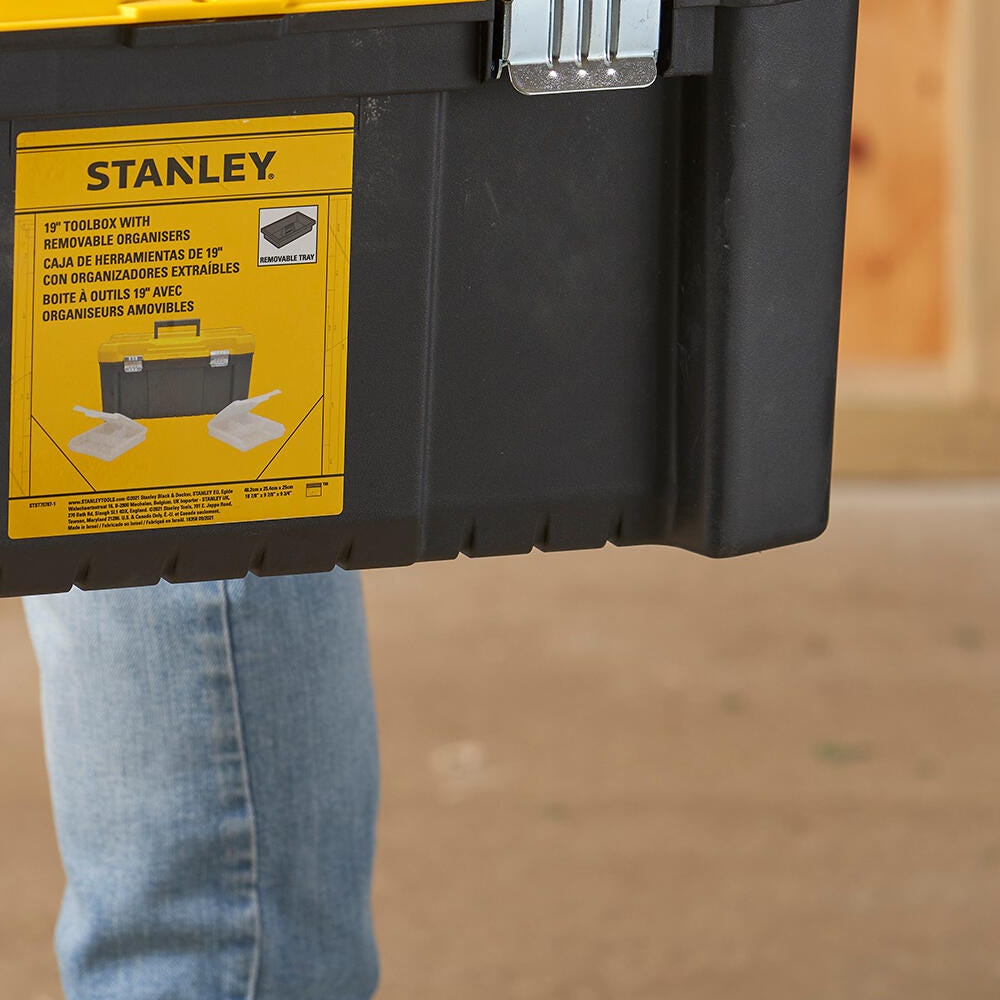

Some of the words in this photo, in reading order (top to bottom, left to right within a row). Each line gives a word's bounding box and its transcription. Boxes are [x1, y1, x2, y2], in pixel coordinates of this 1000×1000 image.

[45, 221, 61, 233] 19"
[64, 218, 117, 232] TOOLBOX
[120, 216, 150, 229] WITH
[44, 235, 114, 250] REMOVABLE
[117, 230, 191, 245] ORGANISERS
[44, 257, 74, 270] CAJA
[78, 256, 92, 267] DE
[96, 249, 185, 266] HERRAMIENTAS
[189, 248, 203, 260] DE
[206, 247, 223, 259] 19"
[260, 254, 298, 263] REMOVABLE
[298, 253, 315, 262] TRAY
[44, 274, 68, 286] CON
[71, 267, 169, 285] ORGANIZADORES
[172, 262, 240, 278] EXTRAÍBLES
[43, 292, 77, 306] BOITE
[79, 288, 87, 302] À
[91, 289, 131, 302] OUTILS
[134, 288, 151, 299] 19"
[153, 285, 183, 298] AVEC
[43, 306, 124, 322] ORGANISEURS
[127, 301, 194, 316] AMOVIBLES
